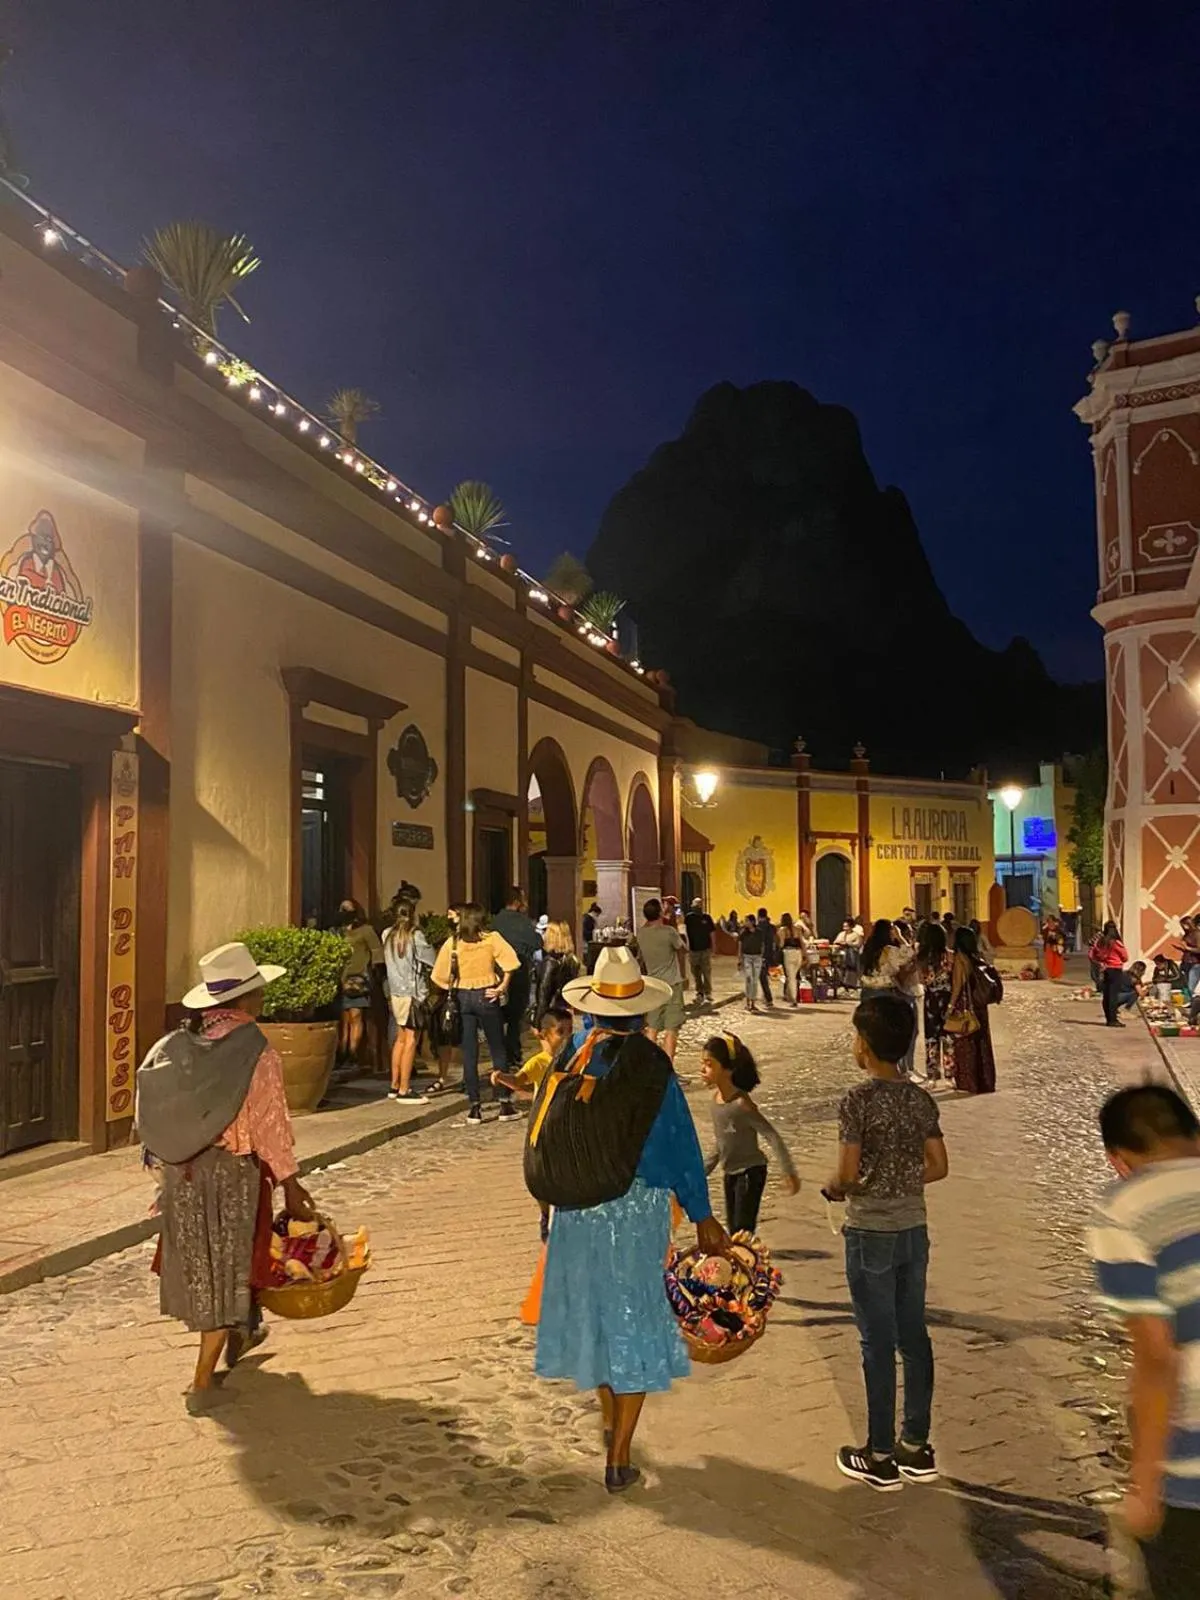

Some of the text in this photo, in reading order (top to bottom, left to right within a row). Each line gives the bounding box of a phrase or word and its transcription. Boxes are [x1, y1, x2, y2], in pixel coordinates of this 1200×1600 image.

[0, 578, 92, 623] an Tradicional
[12, 612, 69, 641] EL NEGRITO
[891, 806, 969, 842] LA AURORA
[876, 843, 918, 860] CENTRO
[108, 984, 134, 1114] QUESO
